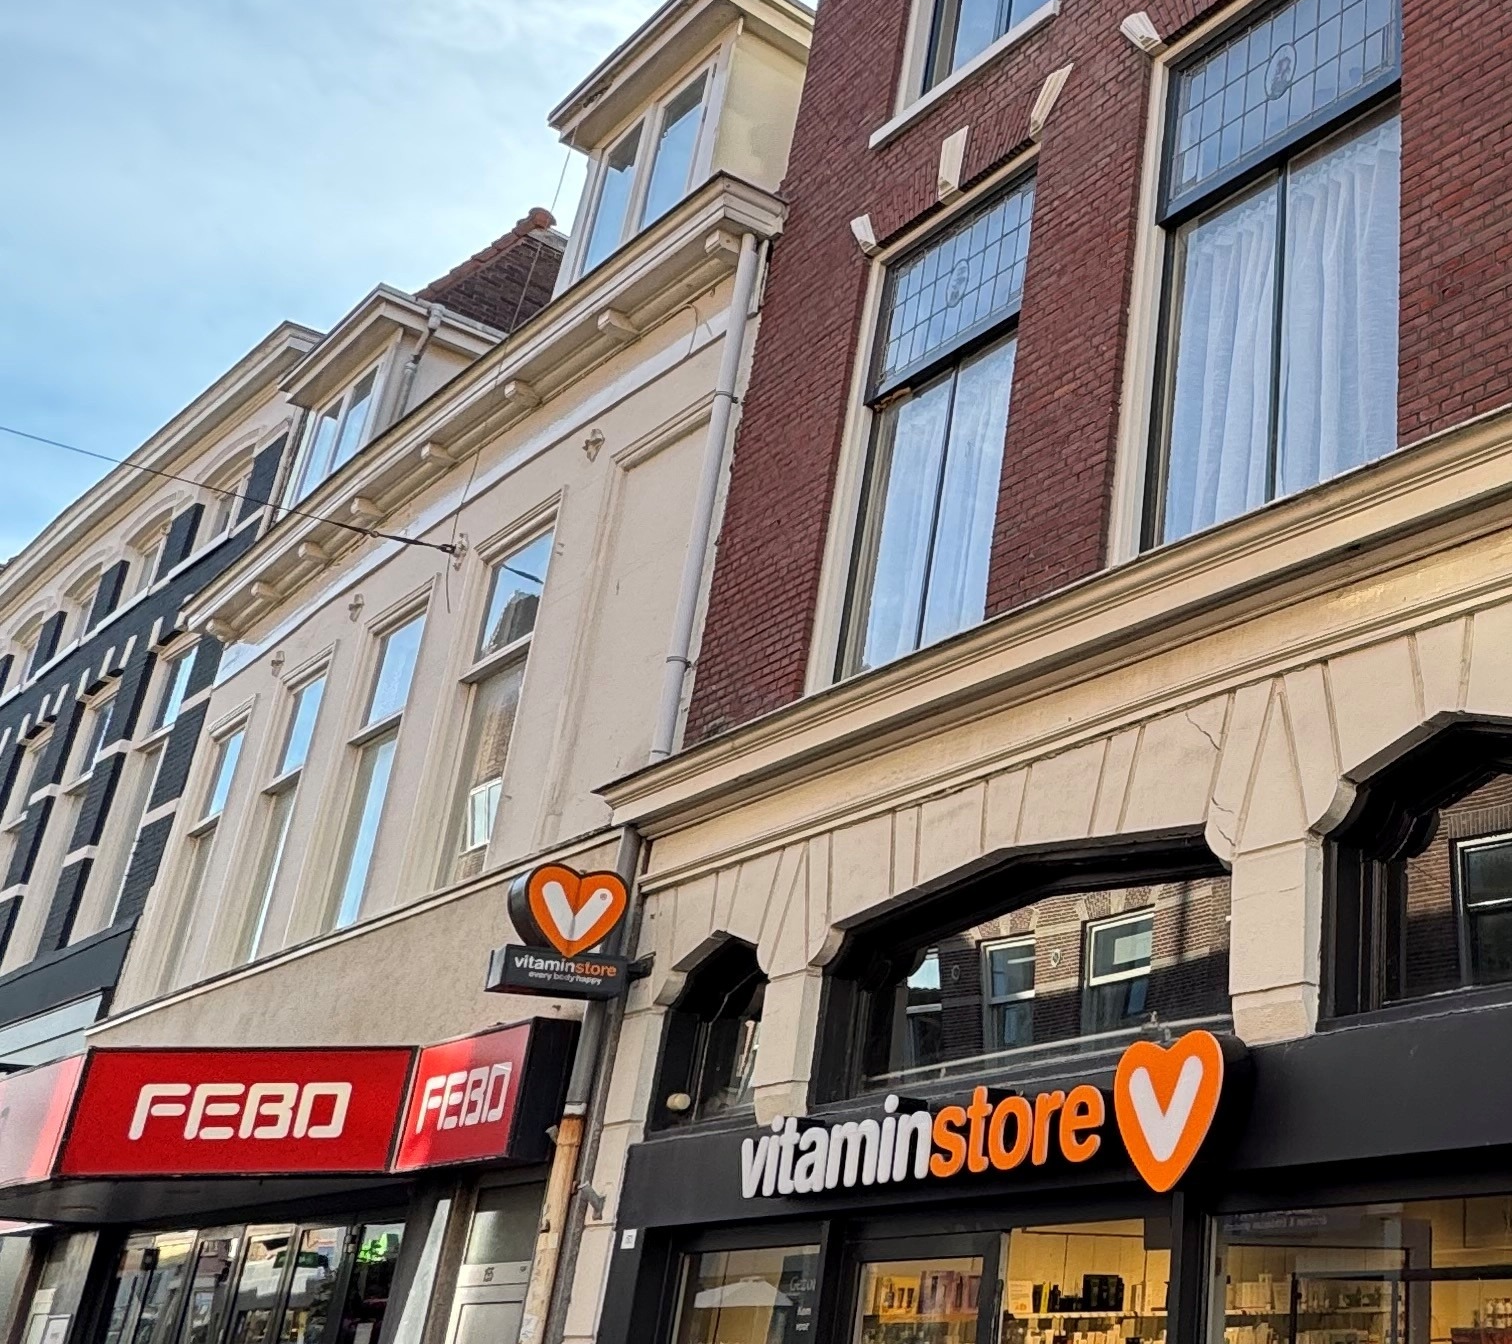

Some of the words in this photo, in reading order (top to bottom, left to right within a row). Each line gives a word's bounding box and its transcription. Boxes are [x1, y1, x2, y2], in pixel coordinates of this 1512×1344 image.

[514, 954, 617, 977] vitaminstore
[128, 1082, 352, 1141] FEBO
[415, 1062, 512, 1135] FEBO
[741, 1084, 1105, 1199] vitaminstore
